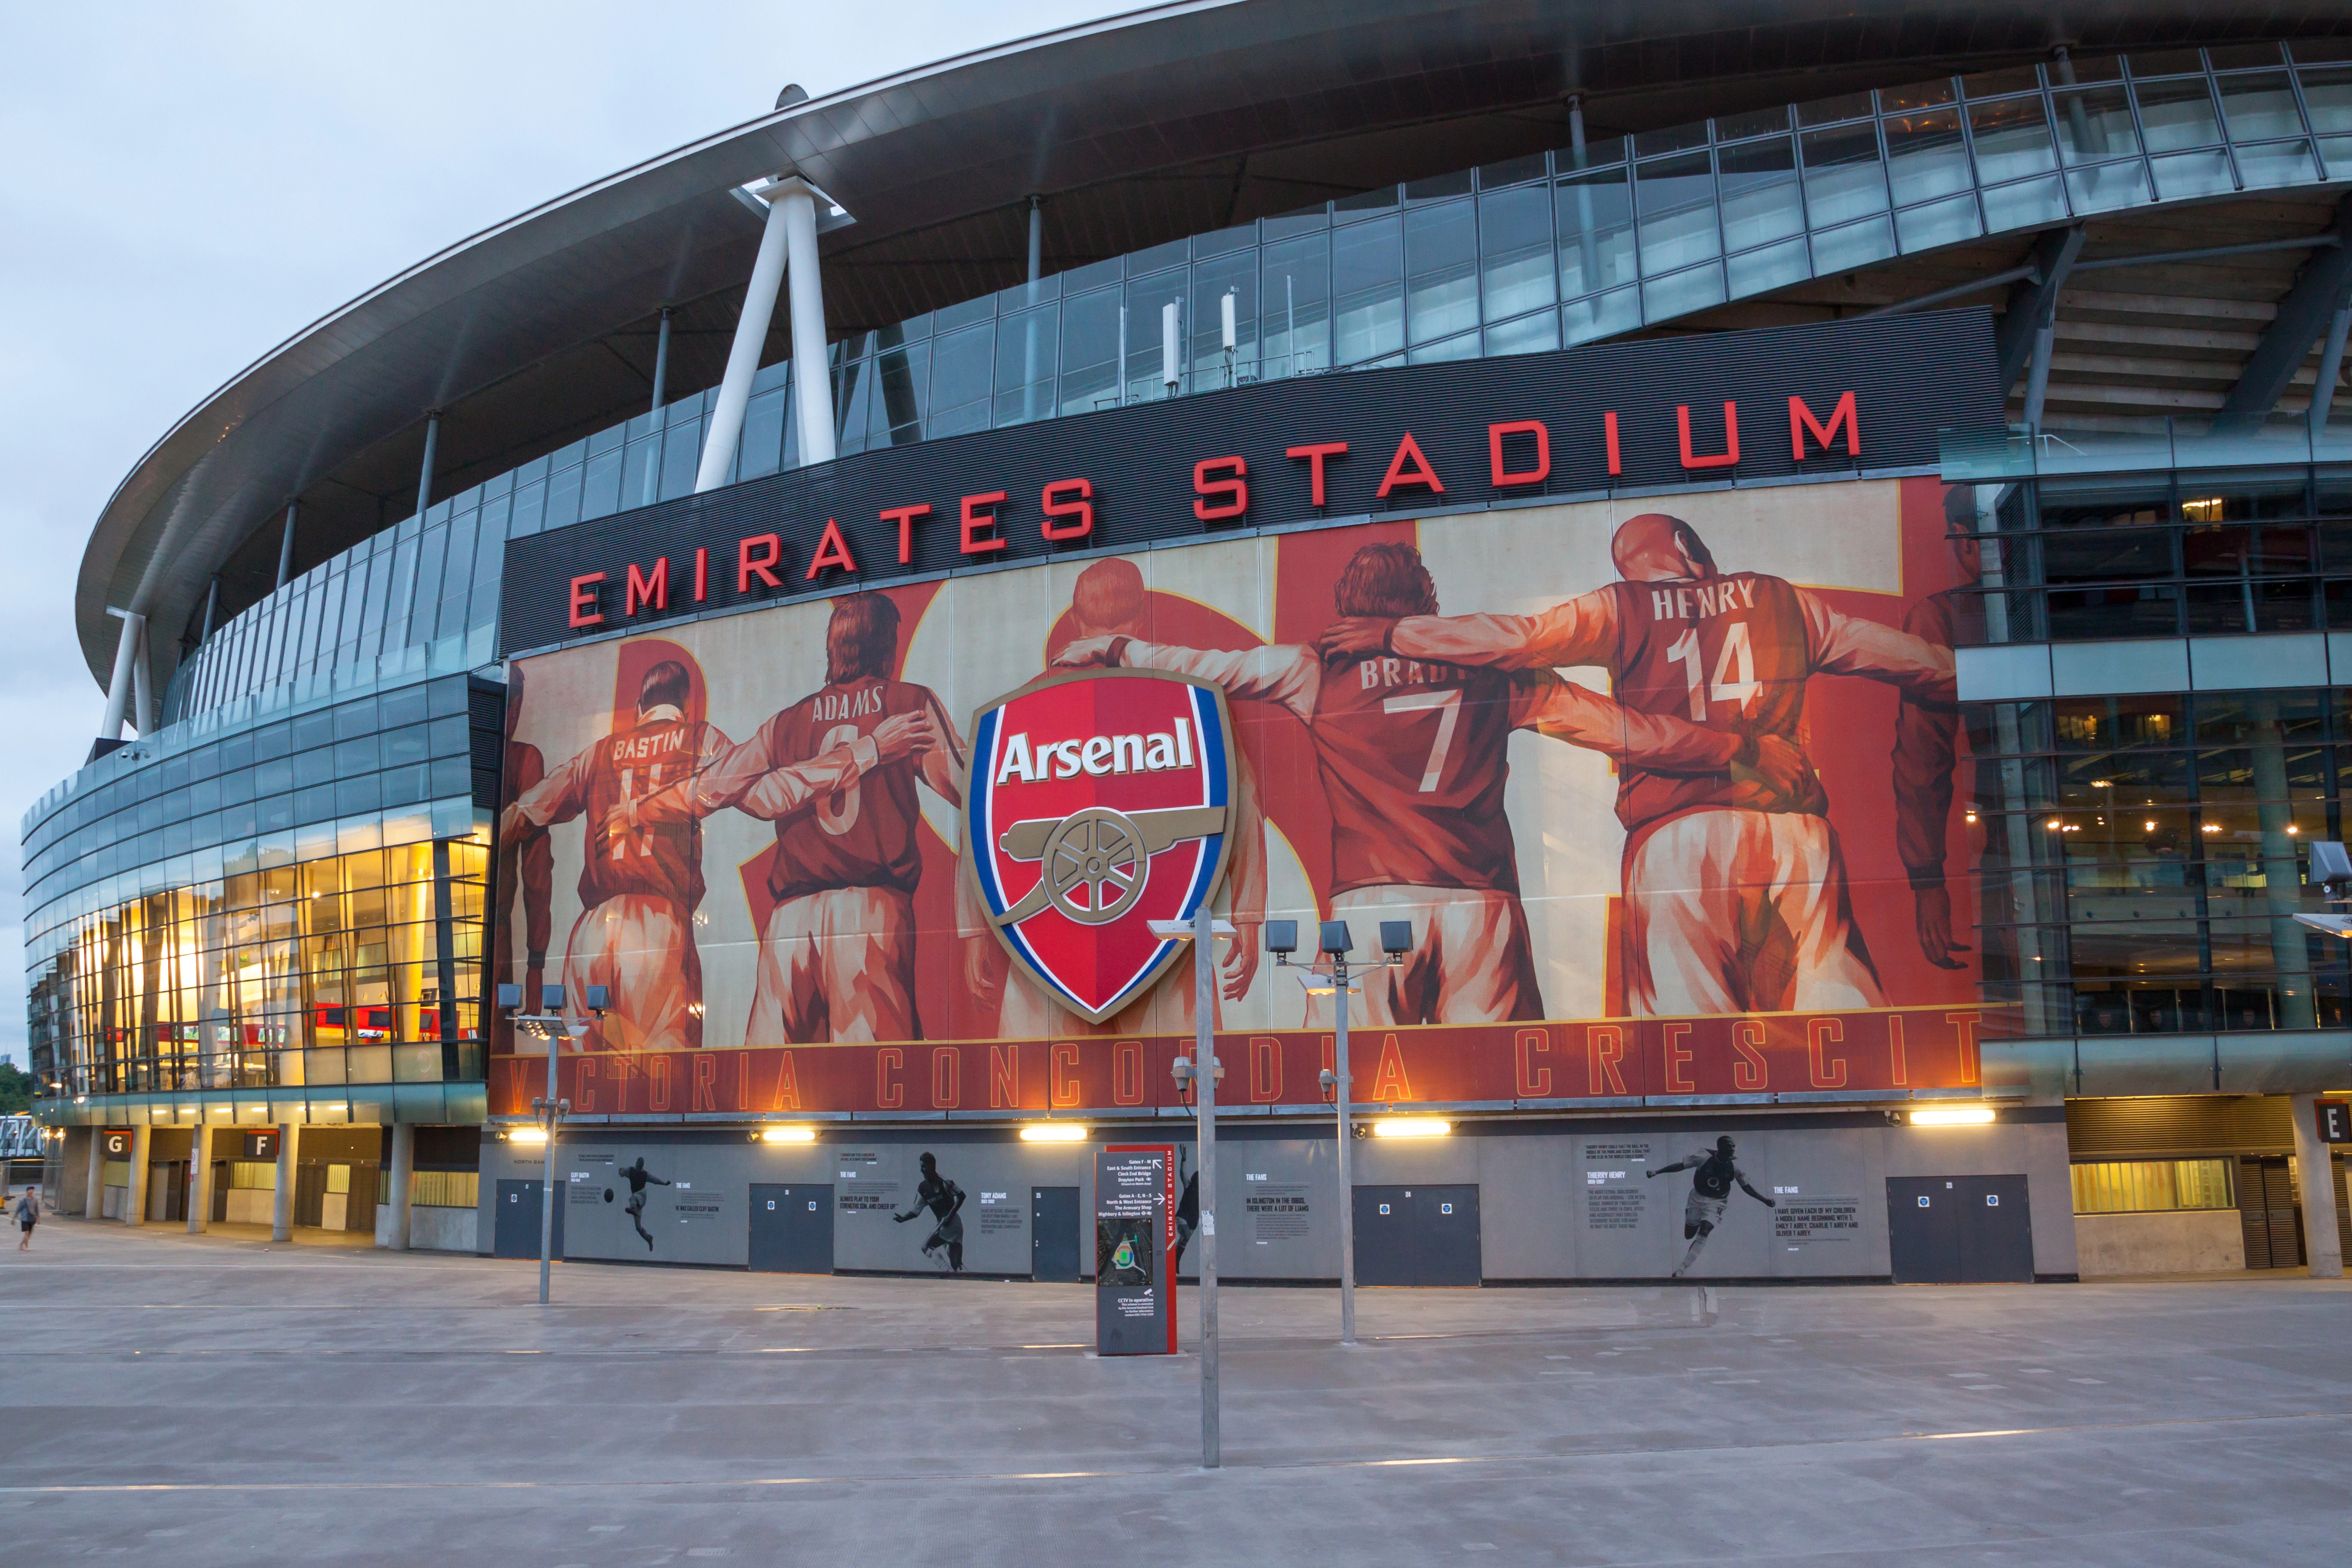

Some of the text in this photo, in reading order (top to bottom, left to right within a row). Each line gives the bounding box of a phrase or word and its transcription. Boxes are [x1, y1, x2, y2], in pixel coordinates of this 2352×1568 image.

[569, 391, 1861, 628] EMIRATES STADIUM
[1652, 578, 1756, 620] HENRY
[1666, 622, 1763, 721] 14
[812, 686, 883, 723] ADAMS
[613, 729, 684, 761] BASTIN
[996, 718, 1197, 786] Arsenal
[1383, 688, 1463, 792] 7
[510, 1050, 801, 1113] VCTORIA
[1515, 1012, 1982, 1096] CRESCIT
[108, 1136, 122, 1152] G
[2327, 1108, 2340, 1138] E
[256, 1136, 267, 1155] F
